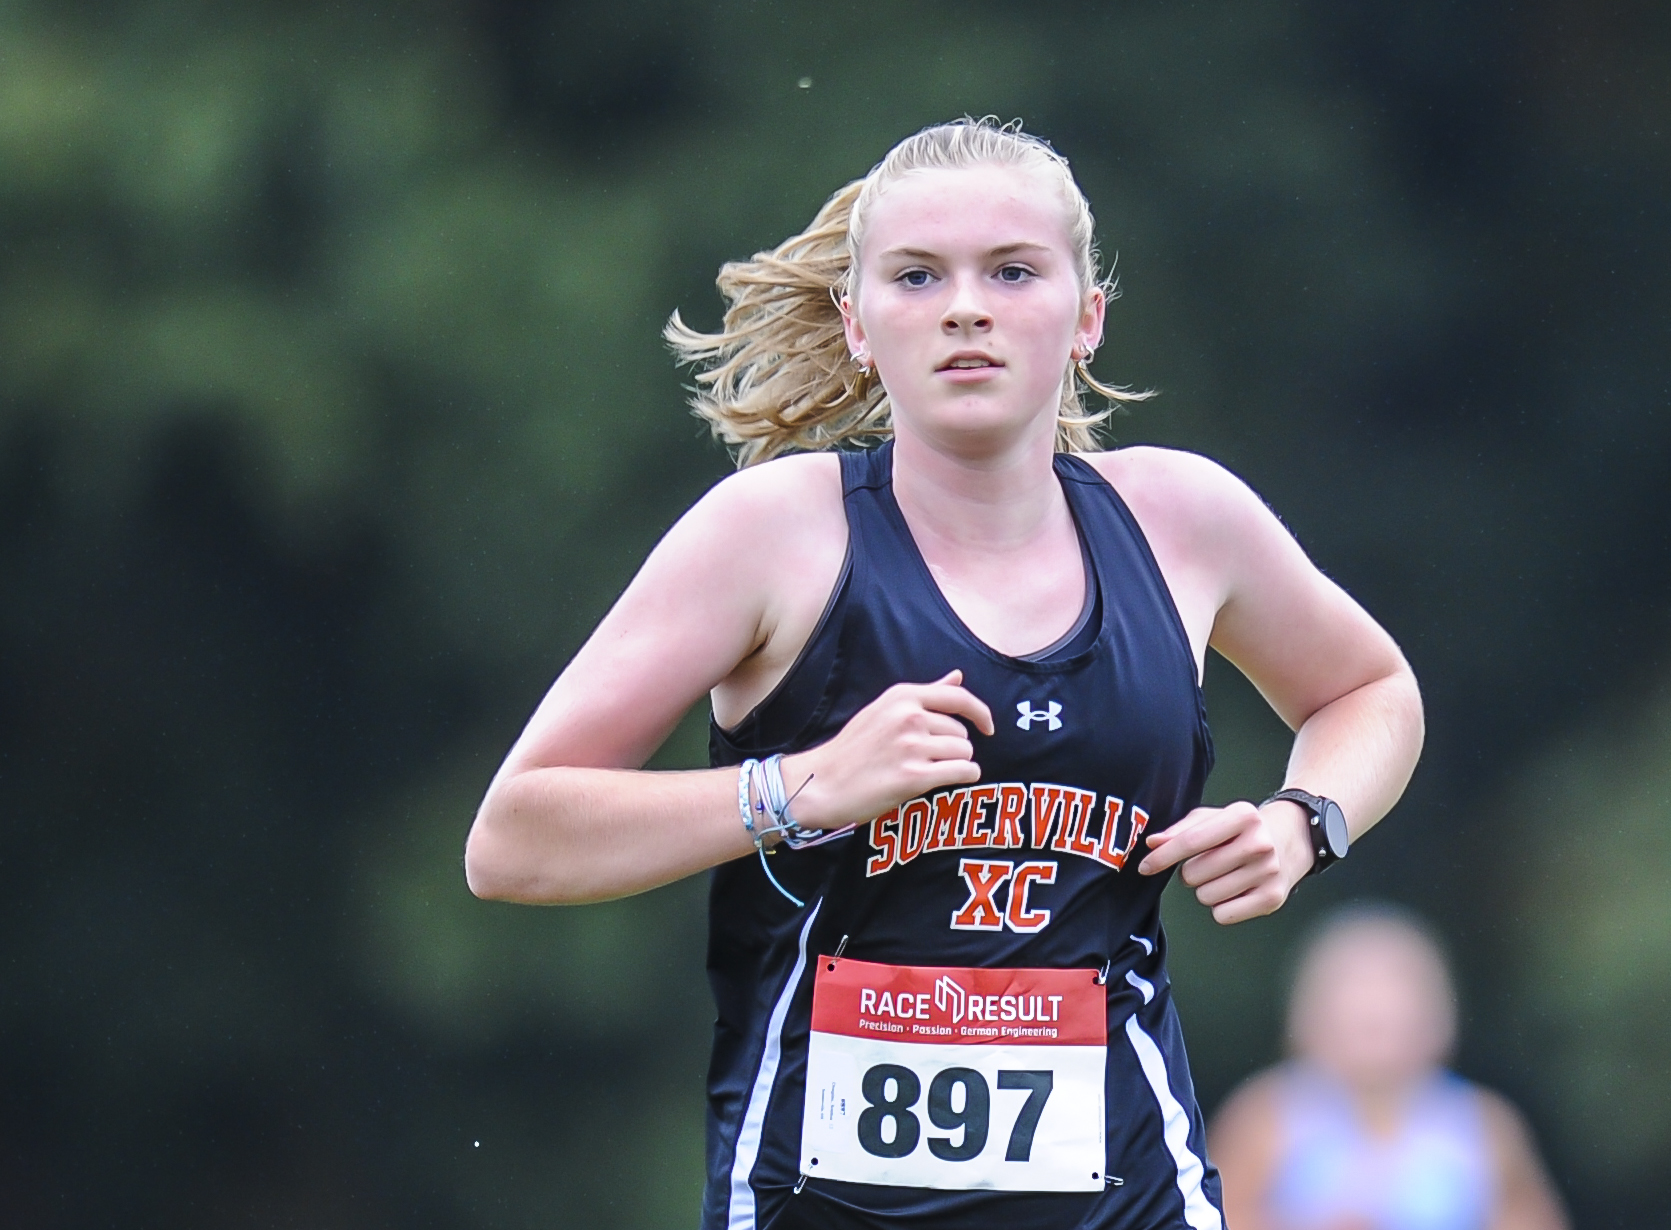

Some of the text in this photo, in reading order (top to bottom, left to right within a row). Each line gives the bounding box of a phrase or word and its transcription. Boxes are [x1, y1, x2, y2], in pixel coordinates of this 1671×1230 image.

[950, 858, 1058, 933] XC
[859, 1019, 1058, 1039] Precision Passion German Engineering
[860, 988, 1063, 1022] RACE RESULT
[857, 1063, 1054, 1162] 897
